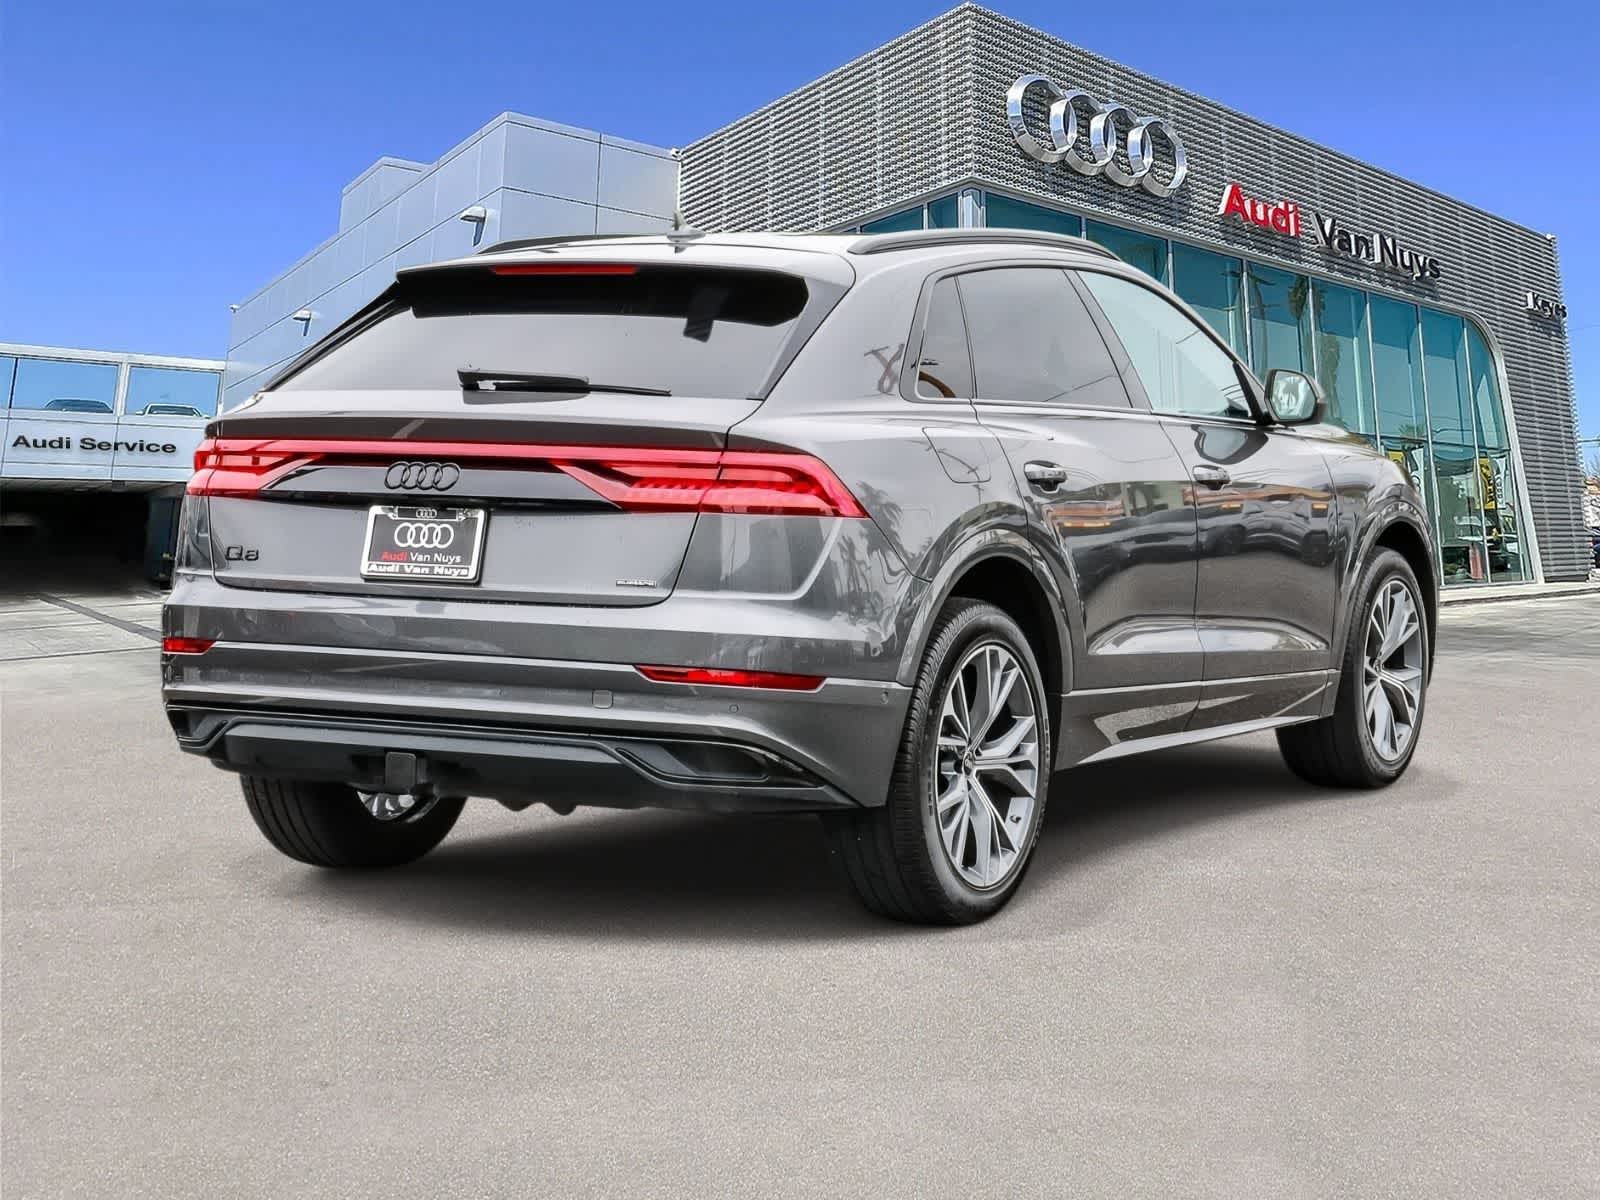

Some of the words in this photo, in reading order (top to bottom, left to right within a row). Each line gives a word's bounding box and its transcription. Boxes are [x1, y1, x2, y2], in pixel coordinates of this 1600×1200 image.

[1219, 183, 1302, 238] Audi
[1312, 212, 1370, 259] Van
[1374, 233, 1441, 280] Nuys
[12, 435, 71, 449] Audi
[80, 437, 177, 454] Service
[225, 545, 259, 561] Q8
[381, 551, 408, 562] Audi
[410, 552, 431, 562] Van
[433, 553, 461, 564] Nuys
[368, 563, 399, 573] Audi
[404, 565, 430, 574] Van
